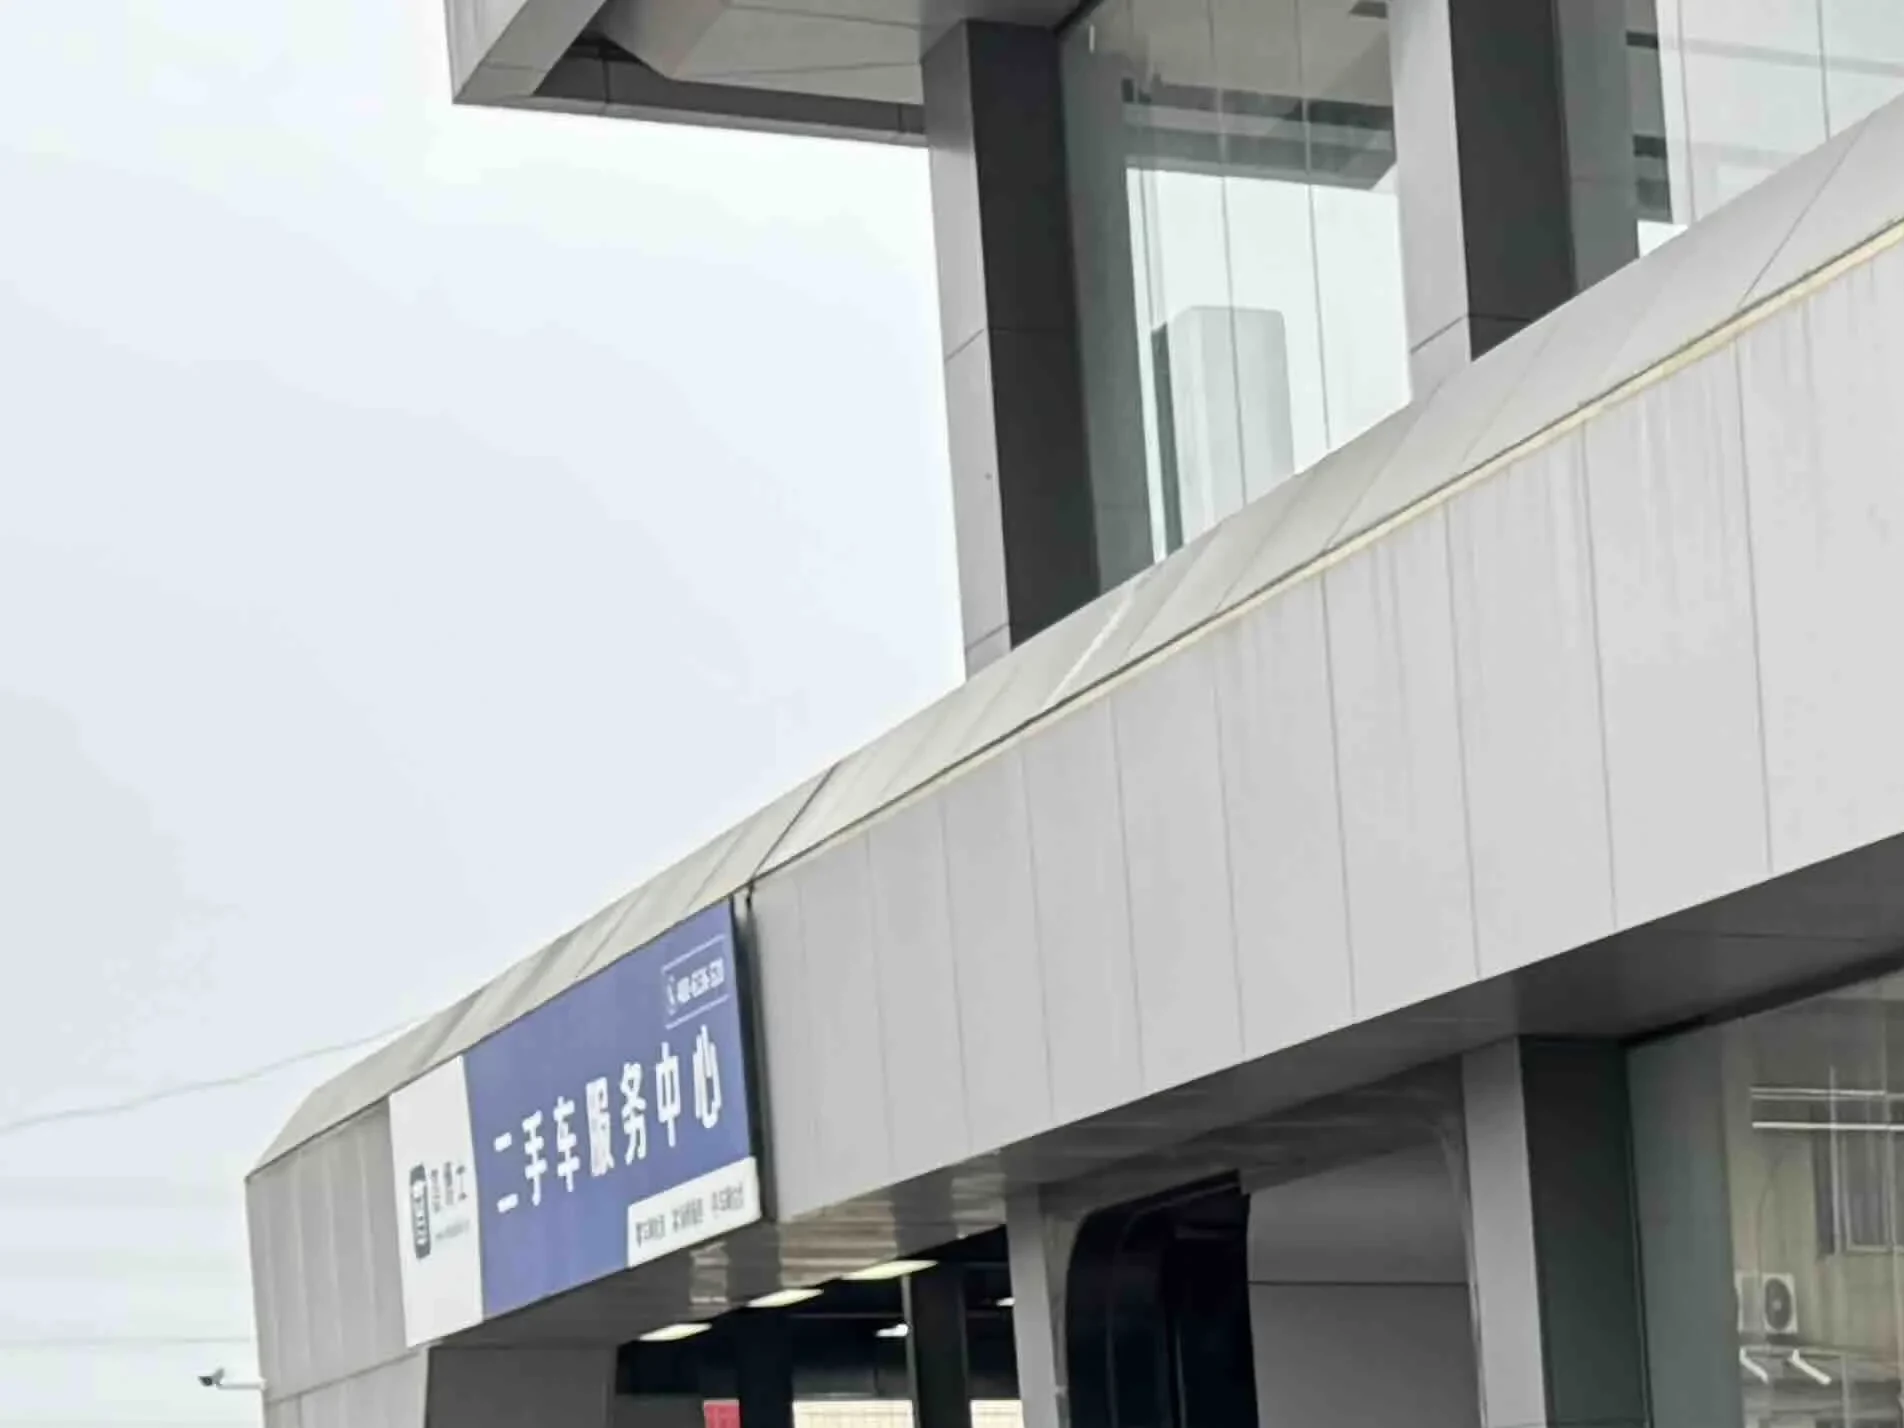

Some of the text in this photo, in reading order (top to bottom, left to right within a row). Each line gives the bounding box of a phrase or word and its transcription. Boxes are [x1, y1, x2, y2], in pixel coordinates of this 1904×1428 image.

[494, 1025, 722, 1213] 二手车服务中心
